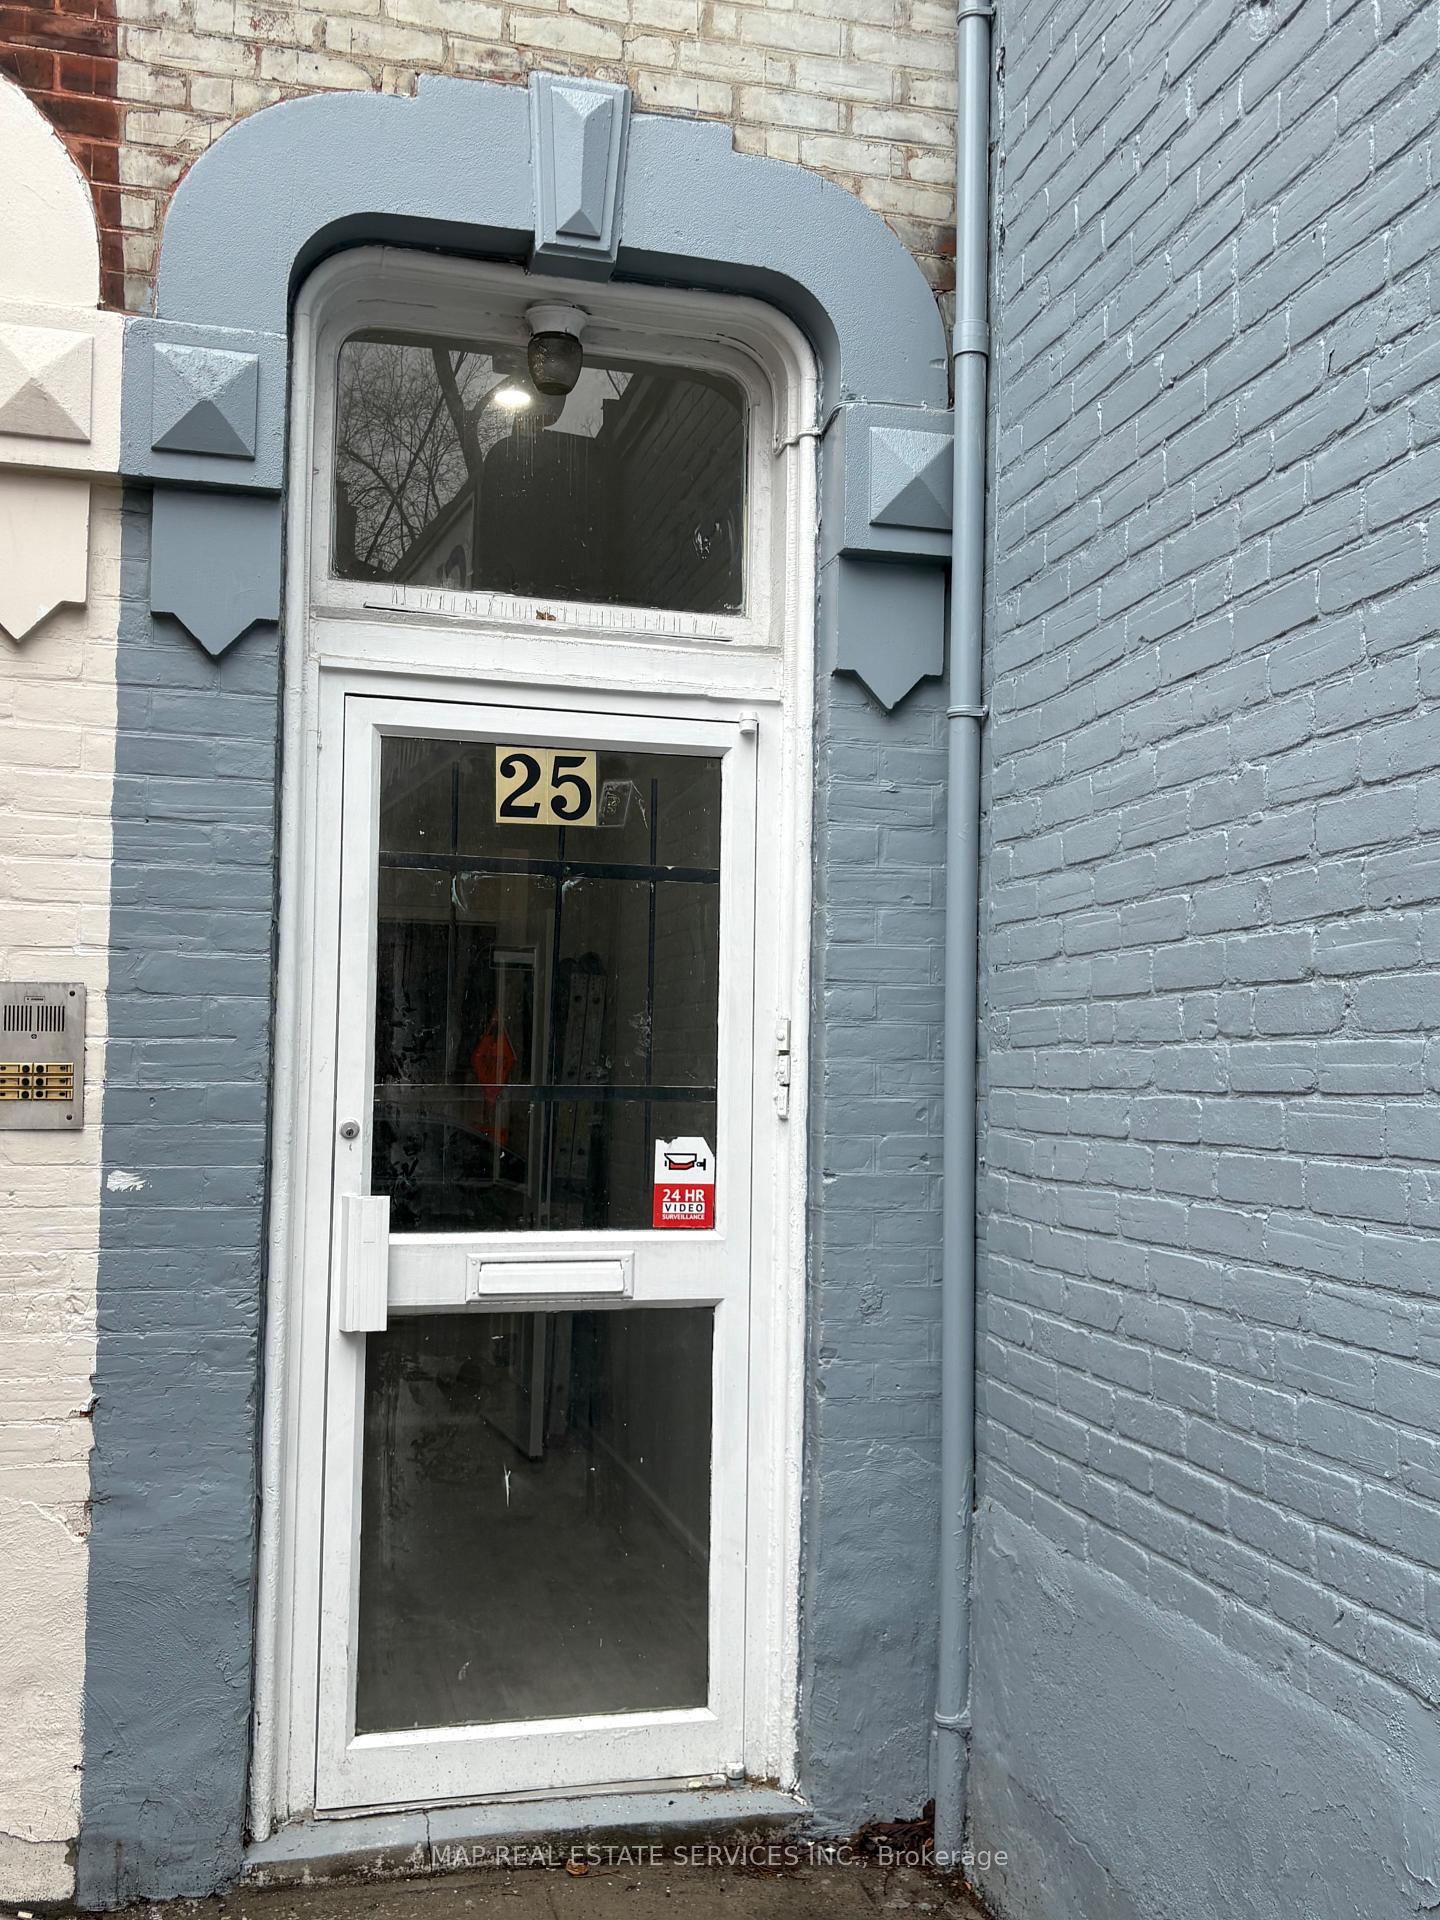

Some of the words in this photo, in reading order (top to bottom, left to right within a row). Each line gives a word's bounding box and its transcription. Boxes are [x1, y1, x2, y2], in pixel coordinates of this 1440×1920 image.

[500, 753, 592, 821] 25
[662, 1189, 681, 1201] 24
[685, 1189, 705, 1201] HR
[665, 1203, 703, 1212] VIDEO
